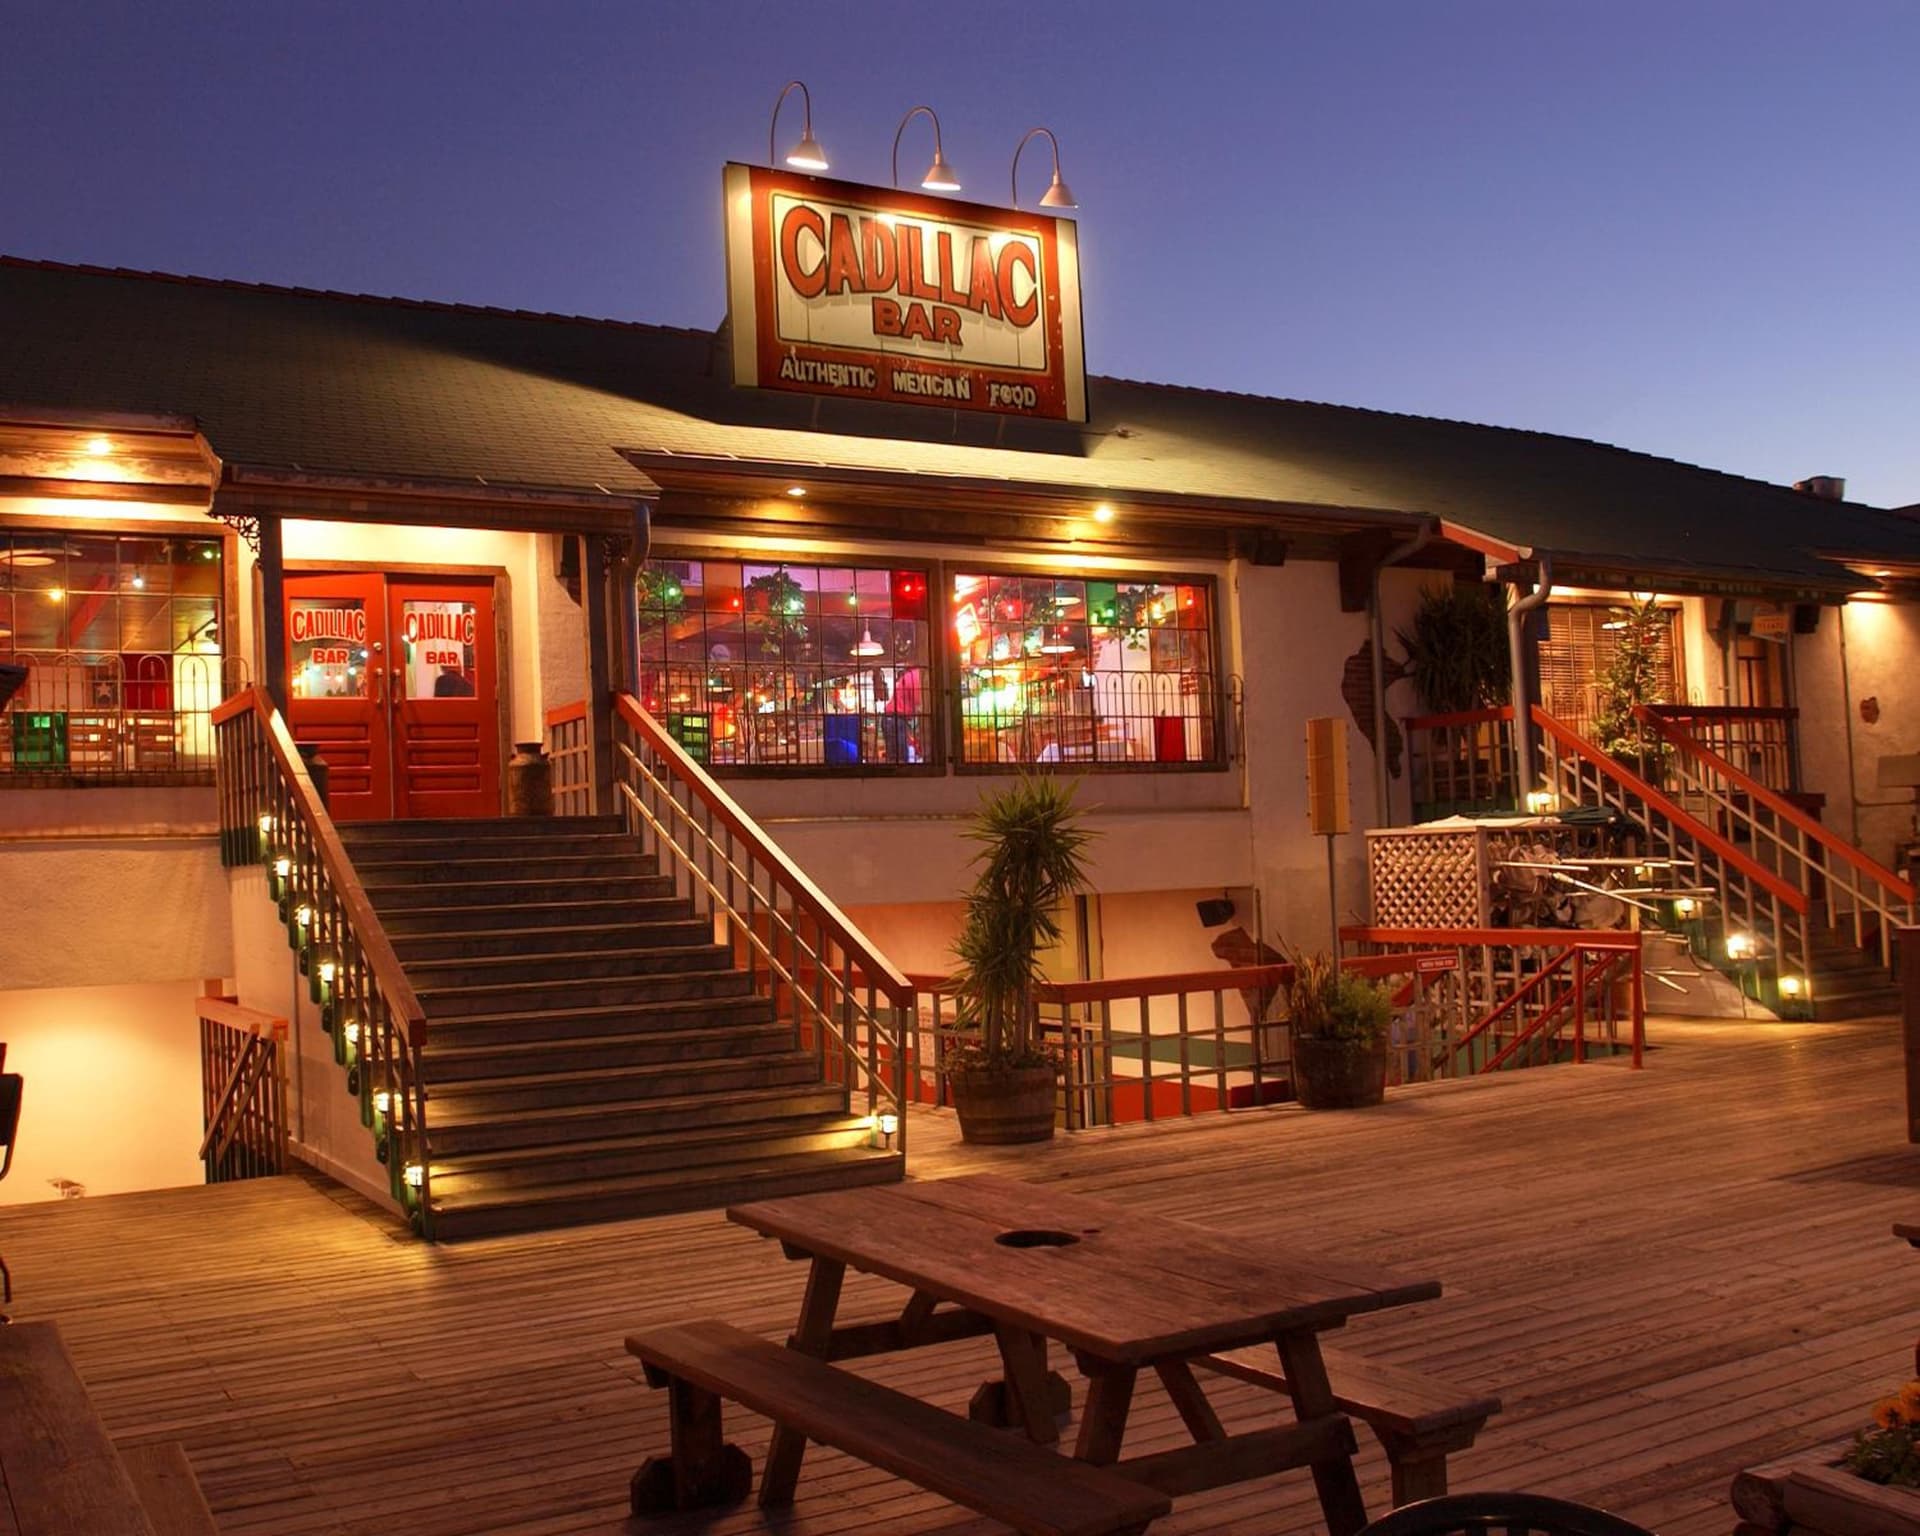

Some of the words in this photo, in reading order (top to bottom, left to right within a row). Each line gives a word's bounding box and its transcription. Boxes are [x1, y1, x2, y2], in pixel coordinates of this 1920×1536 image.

[780, 205, 1038, 328] CADILLAC
[872, 297, 963, 345] BAR
[780, 358, 876, 388] AUTHENTIC
[893, 370, 970, 399] MEXICAN
[990, 383, 1036, 408] FOOD
[291, 609, 366, 642] CADILLAC
[405, 612, 474, 645] CADILLAC
[312, 648, 349, 665] BAR
[425, 651, 459, 664] BAR
